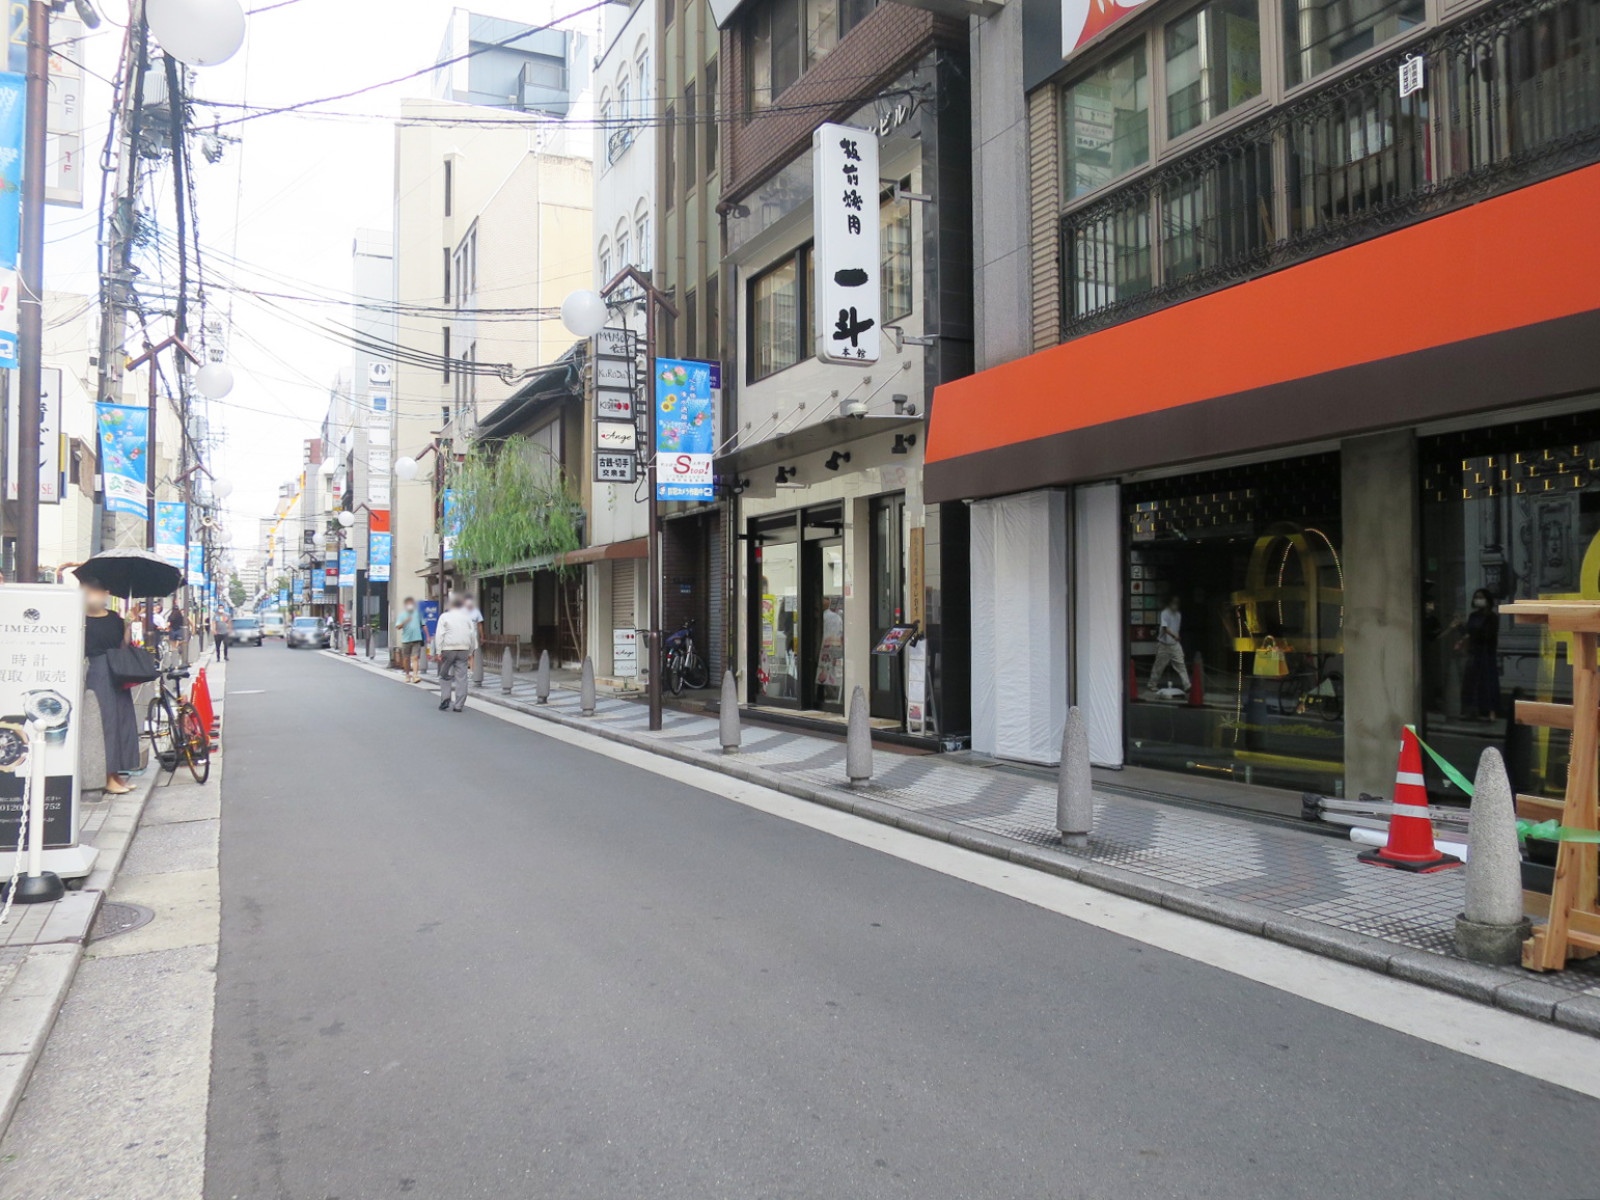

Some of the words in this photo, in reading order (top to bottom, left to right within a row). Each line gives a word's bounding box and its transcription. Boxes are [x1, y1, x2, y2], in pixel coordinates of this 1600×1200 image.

[839, 137, 864, 235] 板前焼肉
[832, 268, 875, 347] 一斗
[841, 347, 867, 359] 本館
[672, 454, 710, 476] Stop!
[11, 654, 49, 667] 時計
